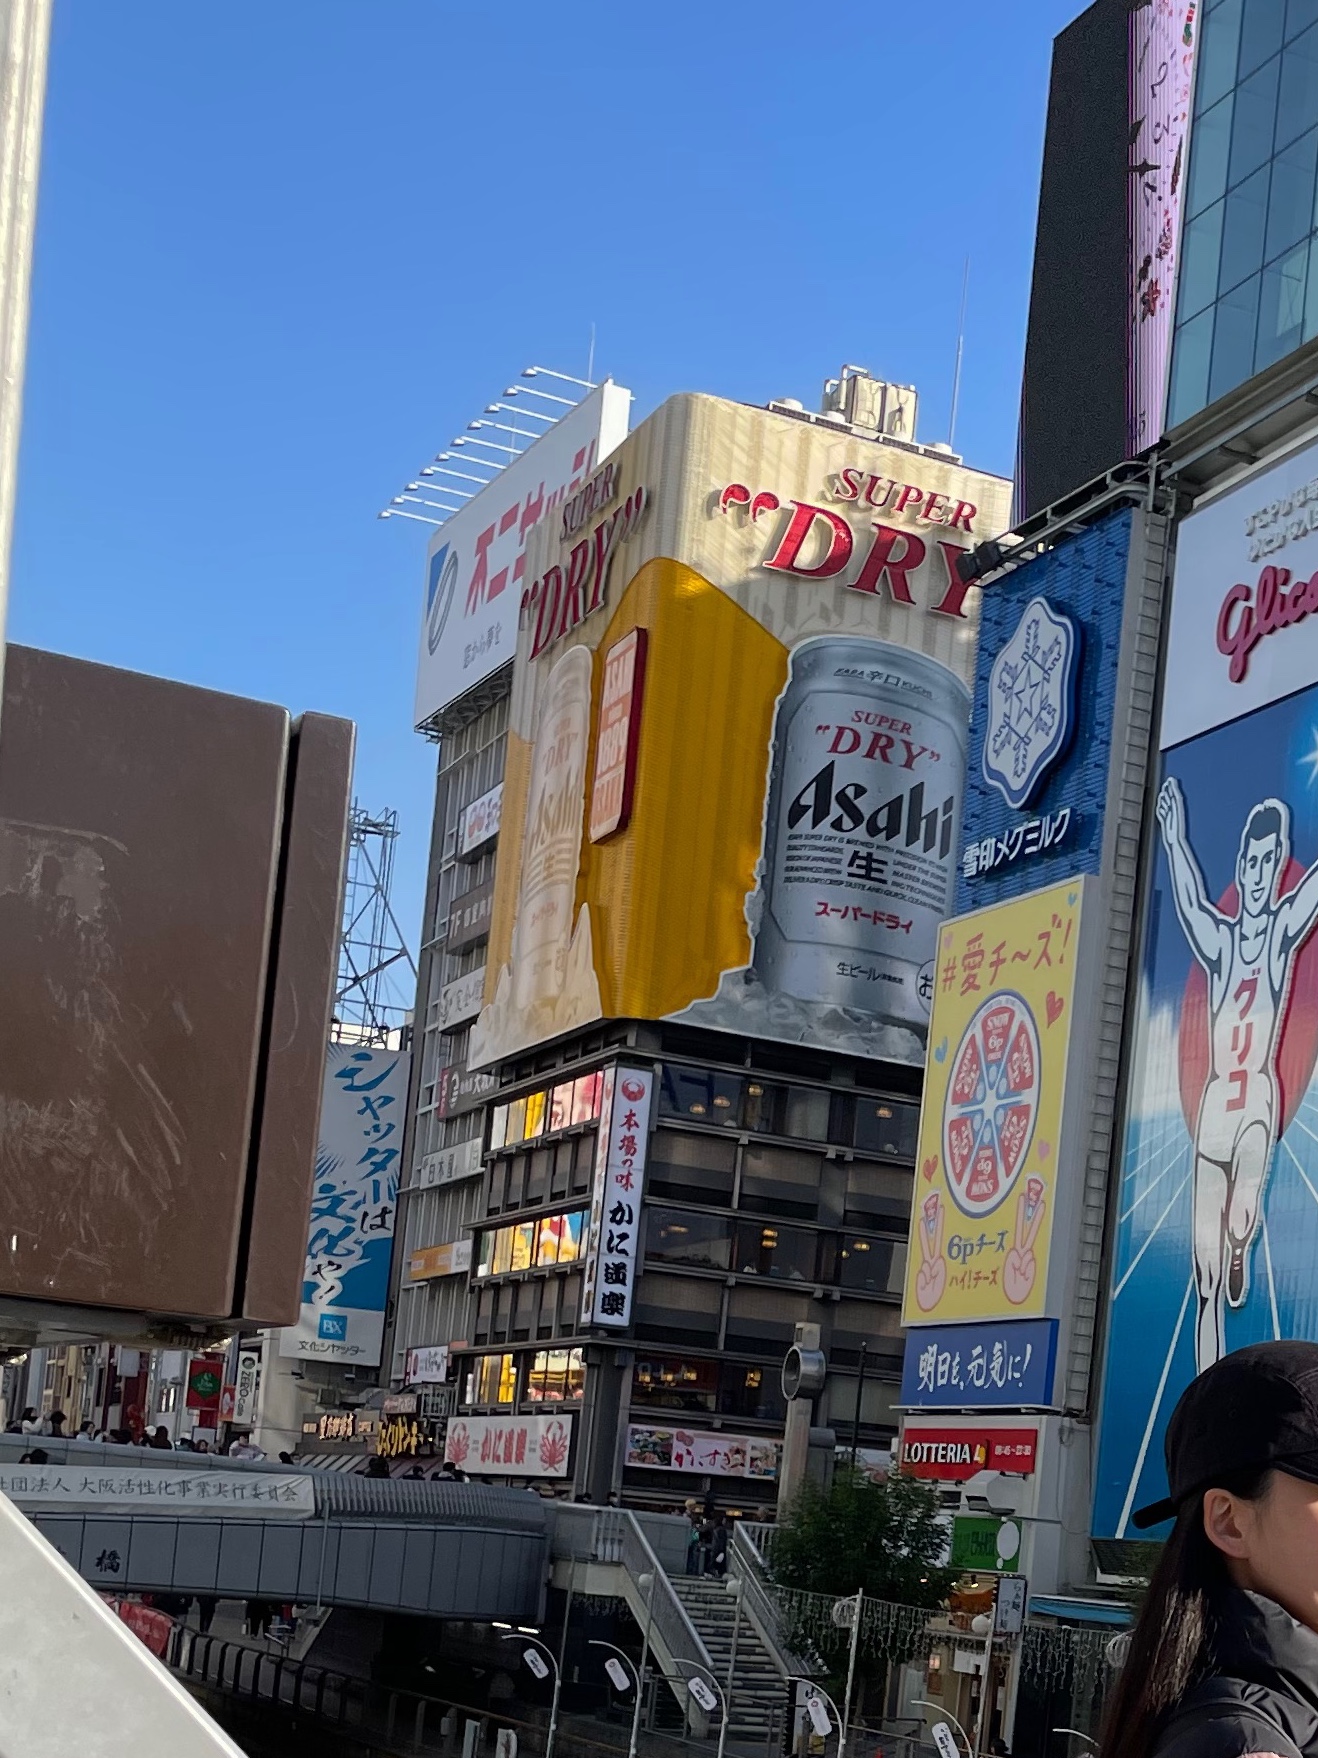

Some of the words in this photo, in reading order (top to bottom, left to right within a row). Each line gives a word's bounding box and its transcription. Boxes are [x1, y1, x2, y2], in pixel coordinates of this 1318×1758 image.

[560, 462, 618, 542] SUPER
[835, 467, 978, 533] SUPER
[851, 710, 912, 736] SUPER
[788, 760, 954, 860] Asahi
[847, 849, 888, 885] 生
[962, 807, 1071, 878] 雪印メグミルク
[815, 902, 914, 934] スーパードライ
[1225, 967, 1262, 1113] グリコ
[322, 1319, 341, 1335] BX
[903, 1442, 971, 1464] LOTTERIA
